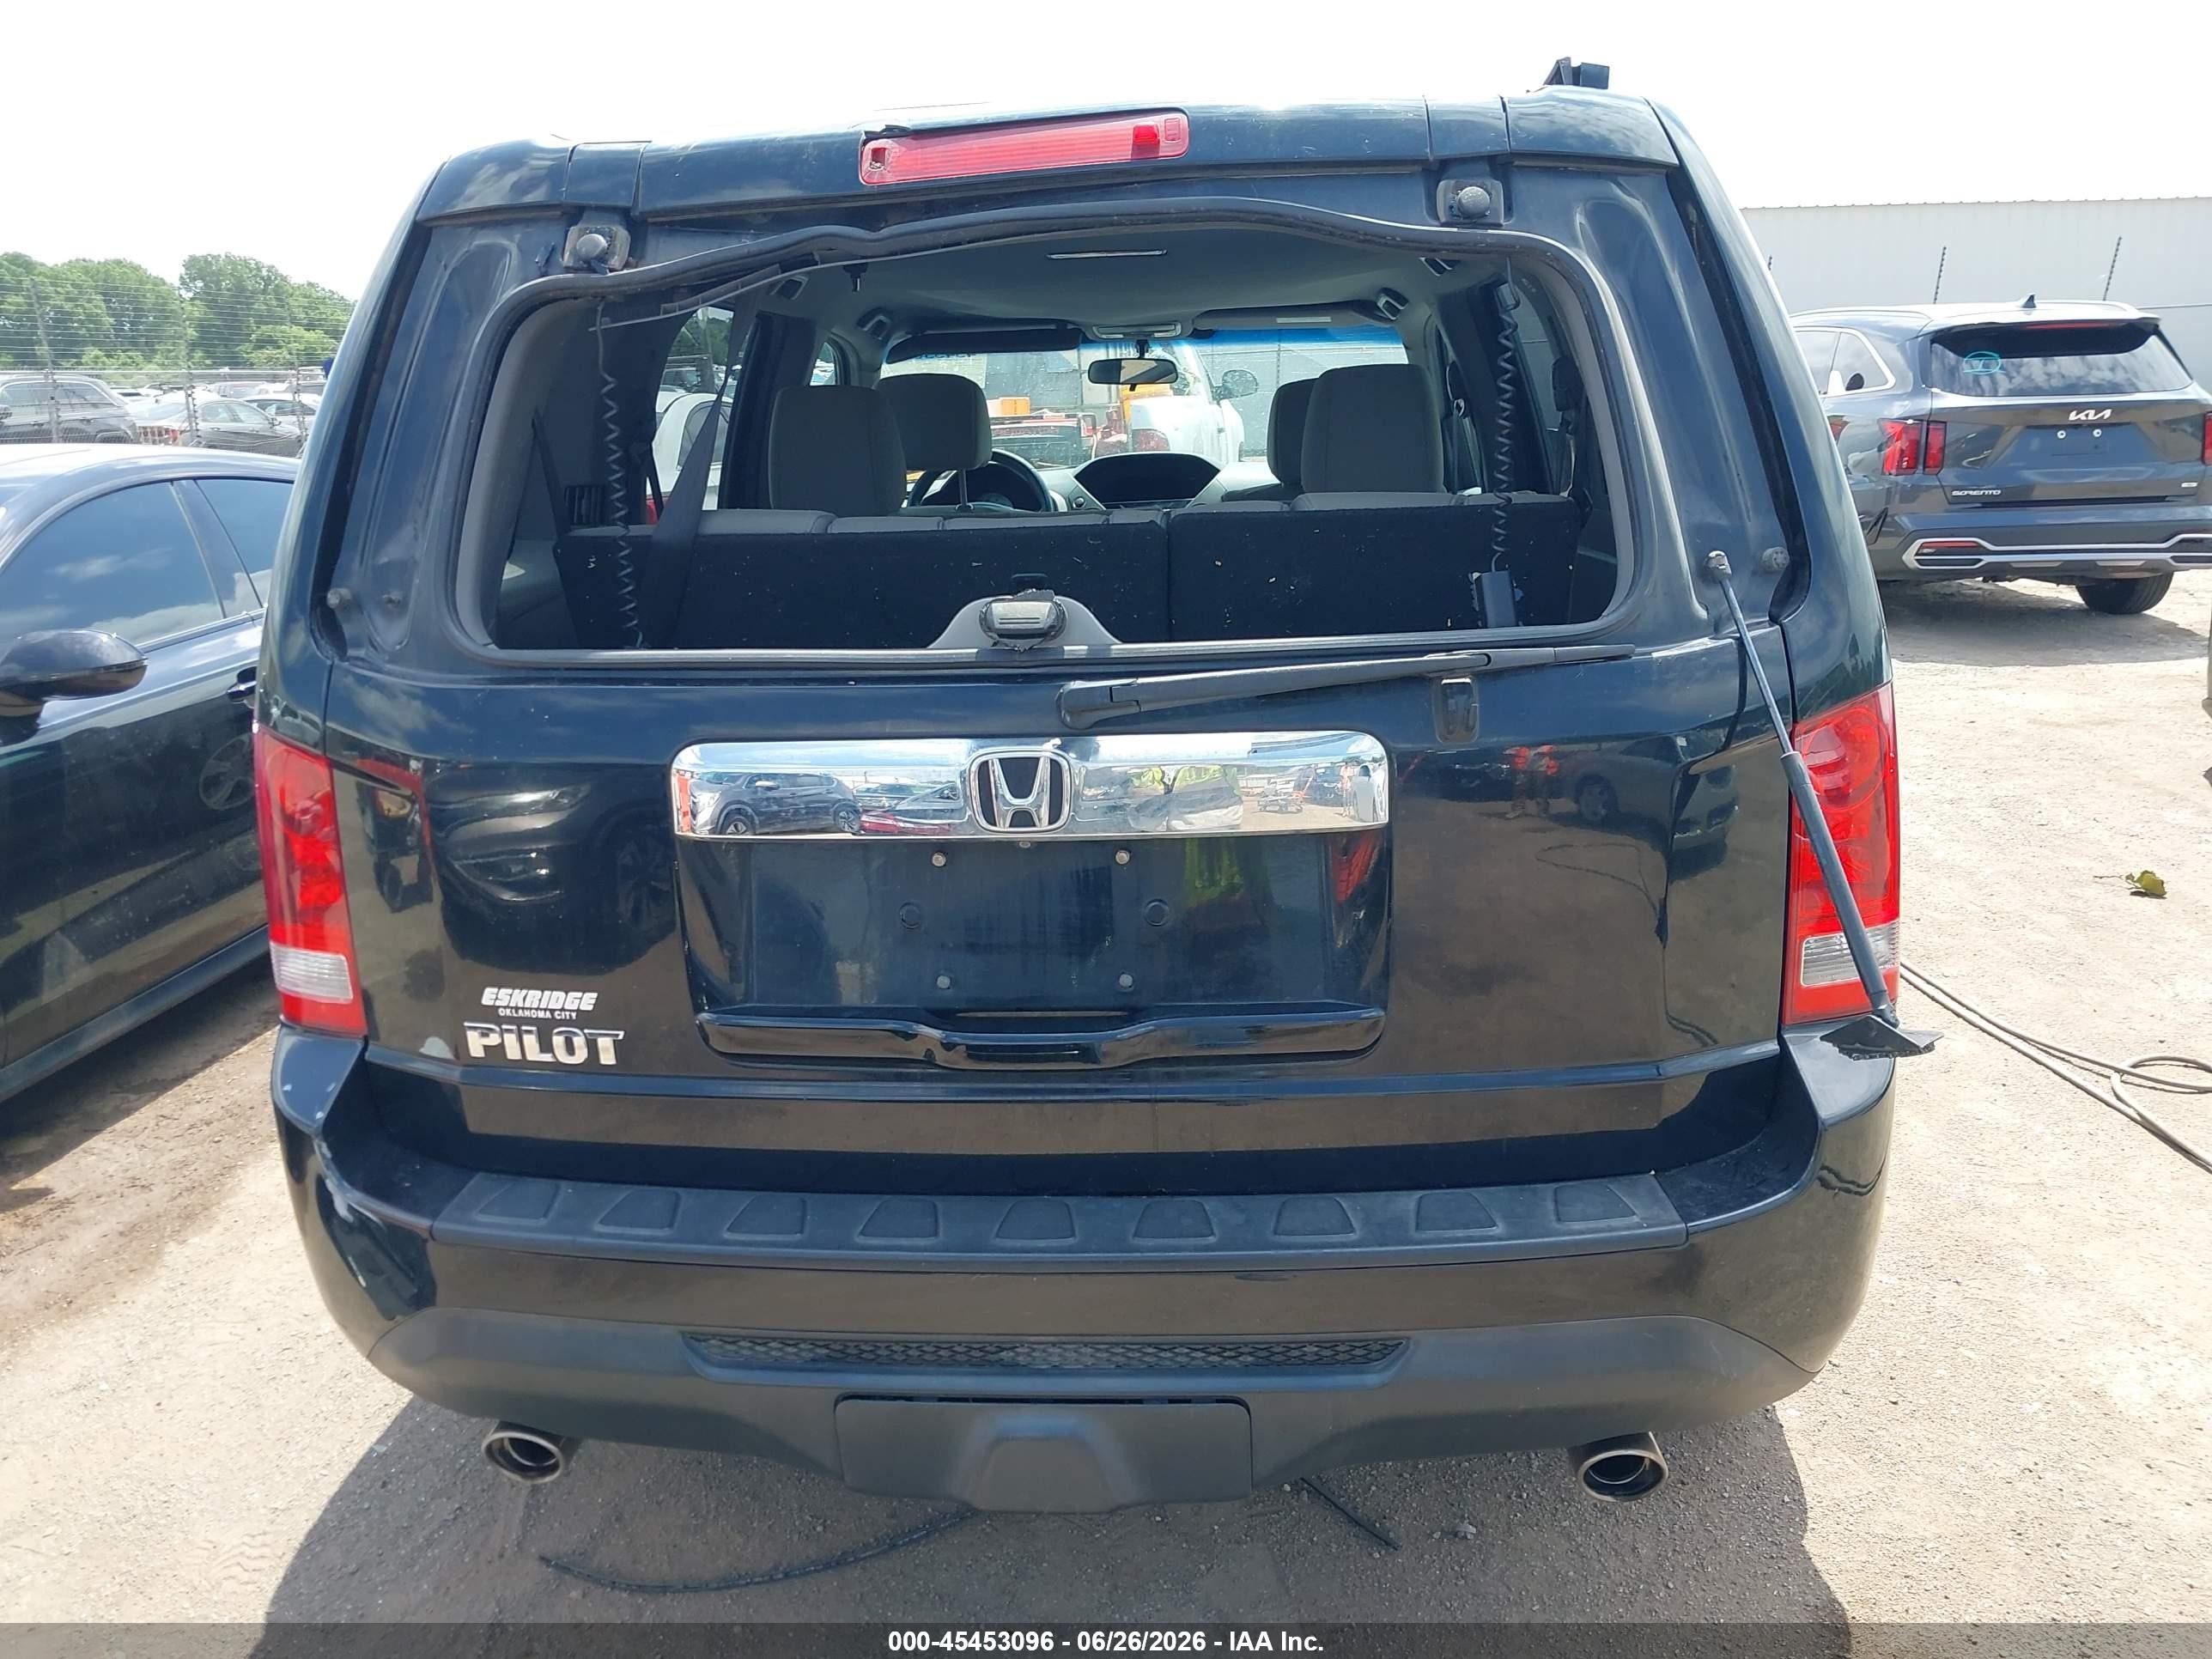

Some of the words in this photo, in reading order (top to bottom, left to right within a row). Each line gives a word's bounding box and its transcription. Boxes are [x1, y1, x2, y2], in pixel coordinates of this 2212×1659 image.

[2069, 409, 2112, 420] KIA
[481, 987, 598, 1011] ESKRIDGE
[498, 1008, 551, 1019] OKLAHOMA
[555, 1012, 577, 1020] CITY
[464, 1021, 625, 1065] PILOT
